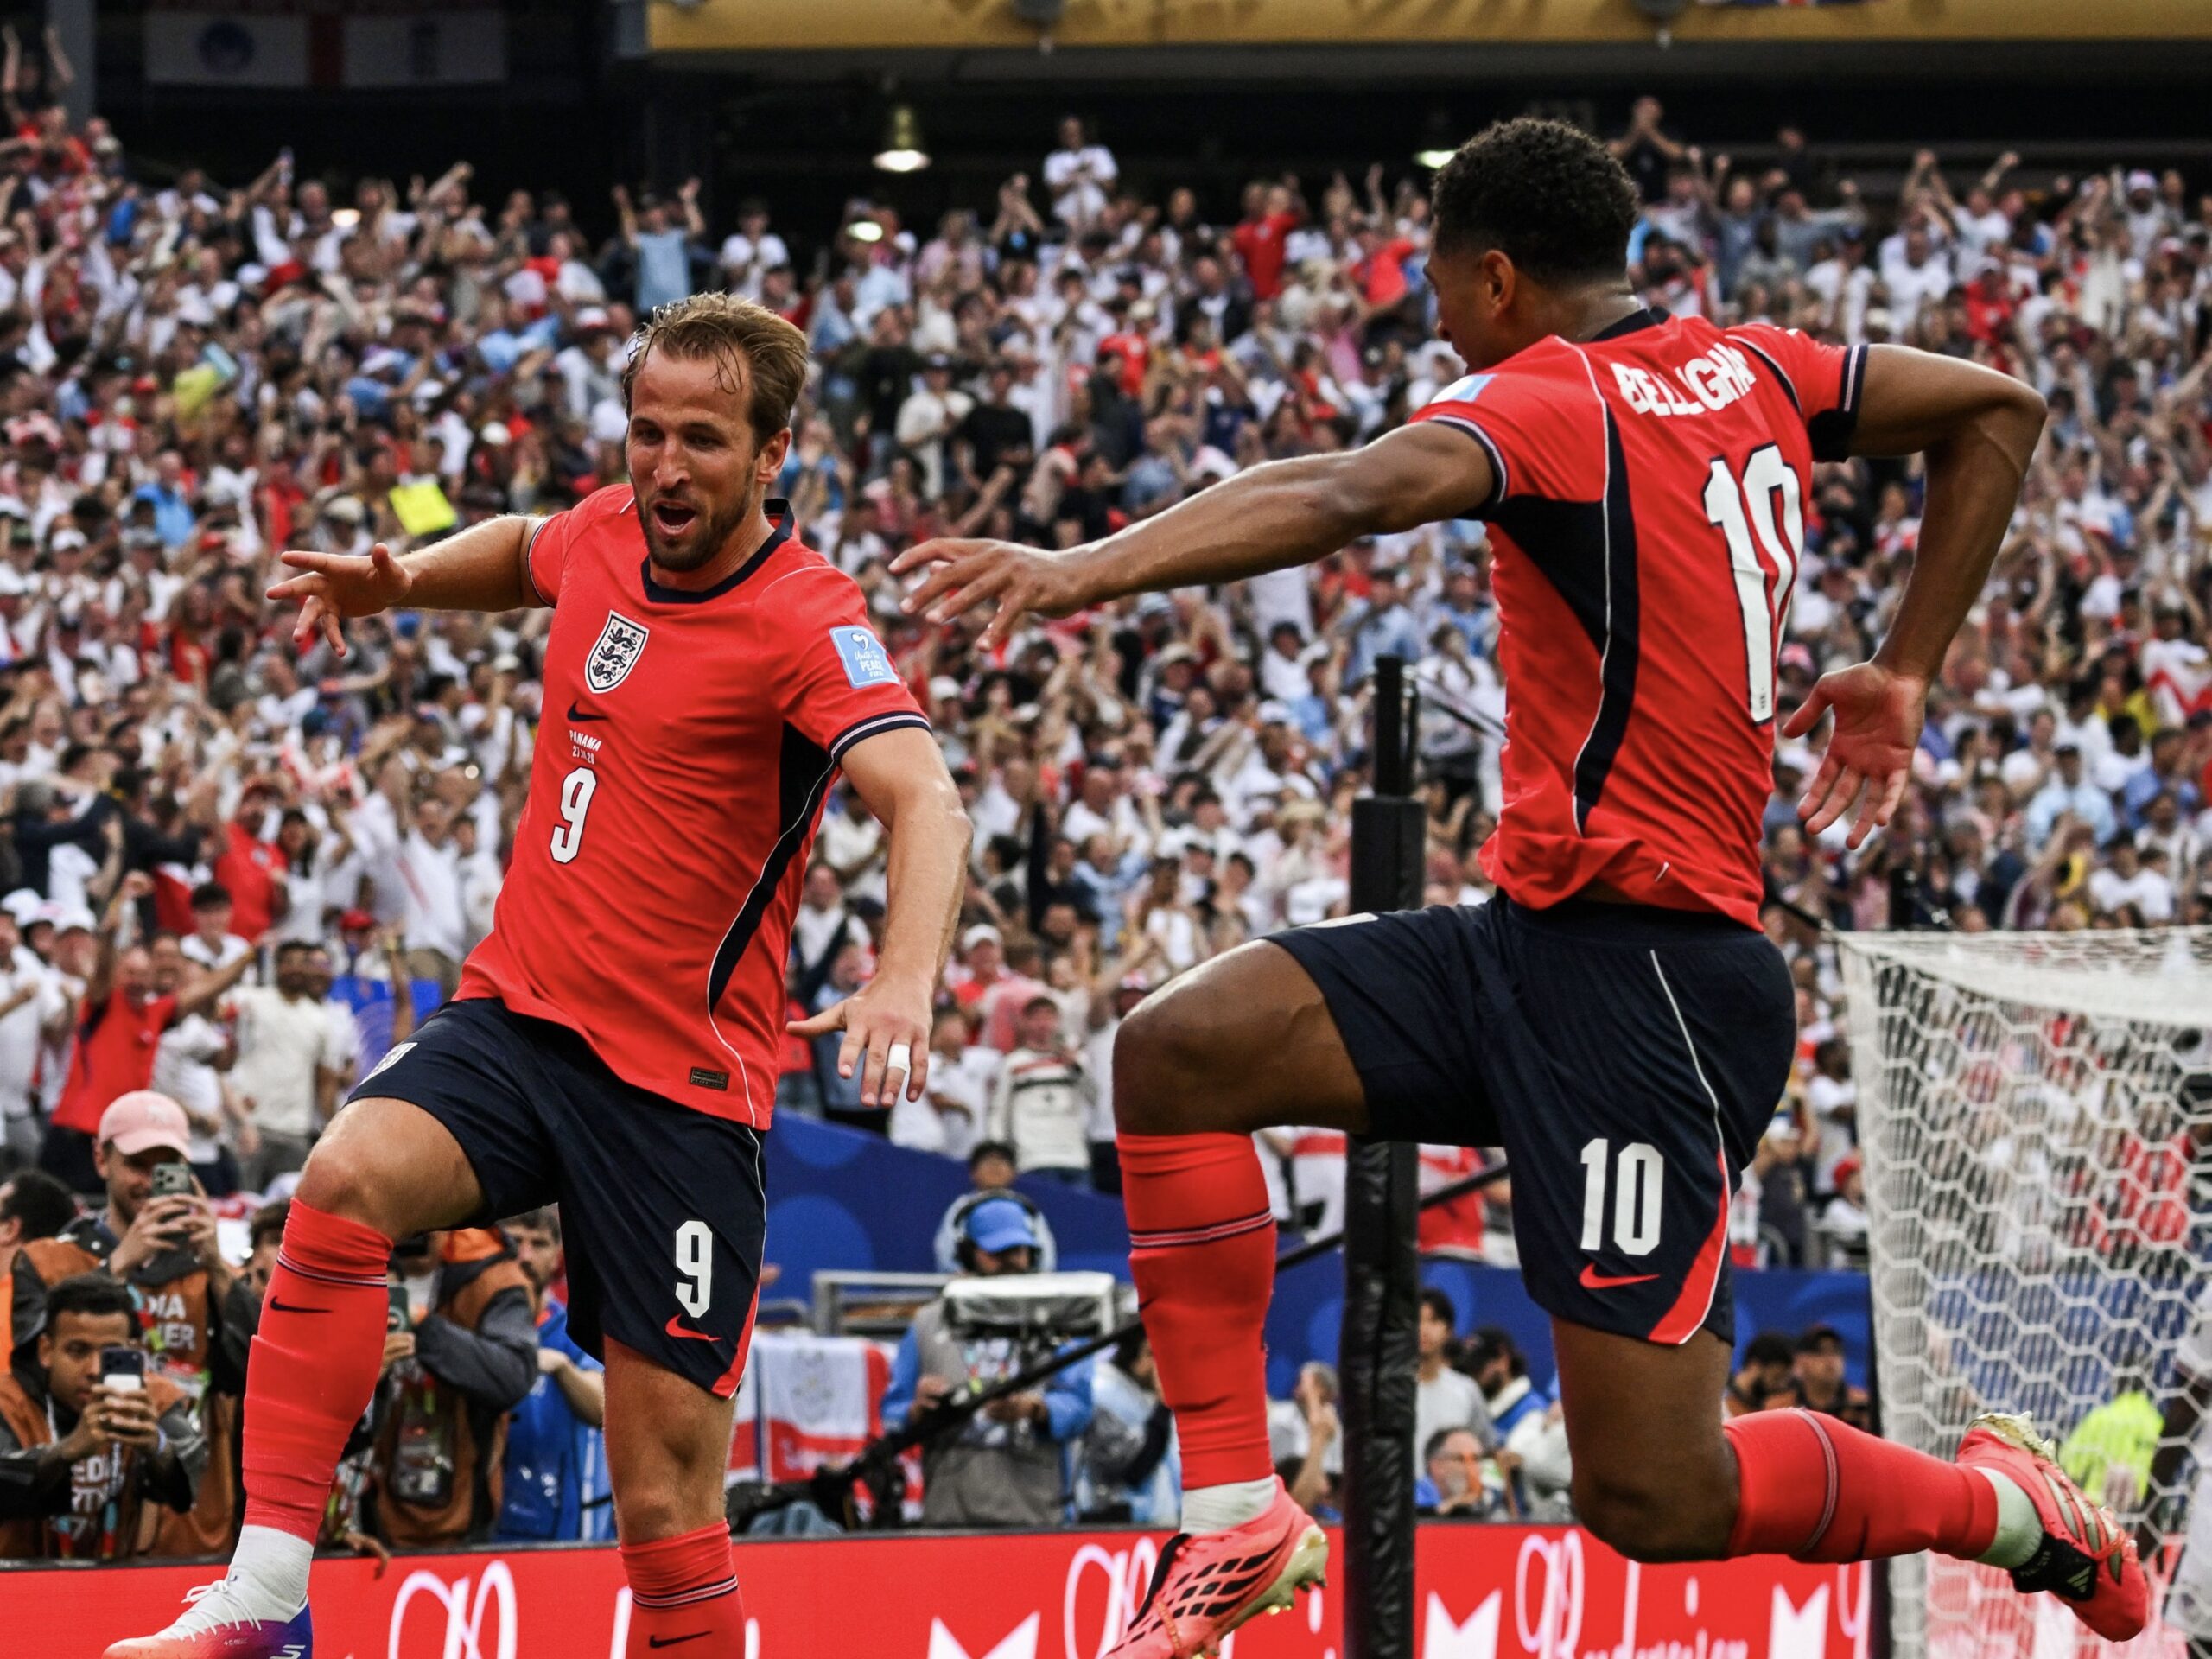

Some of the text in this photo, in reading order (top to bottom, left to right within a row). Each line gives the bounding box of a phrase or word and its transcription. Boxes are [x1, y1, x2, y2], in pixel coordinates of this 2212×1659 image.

[1703, 442, 1803, 726] 10
[569, 729, 602, 752] PANAMA
[550, 766, 597, 864] 9
[1580, 1138, 1663, 1256] 10
[675, 1219, 713, 1319] 9
